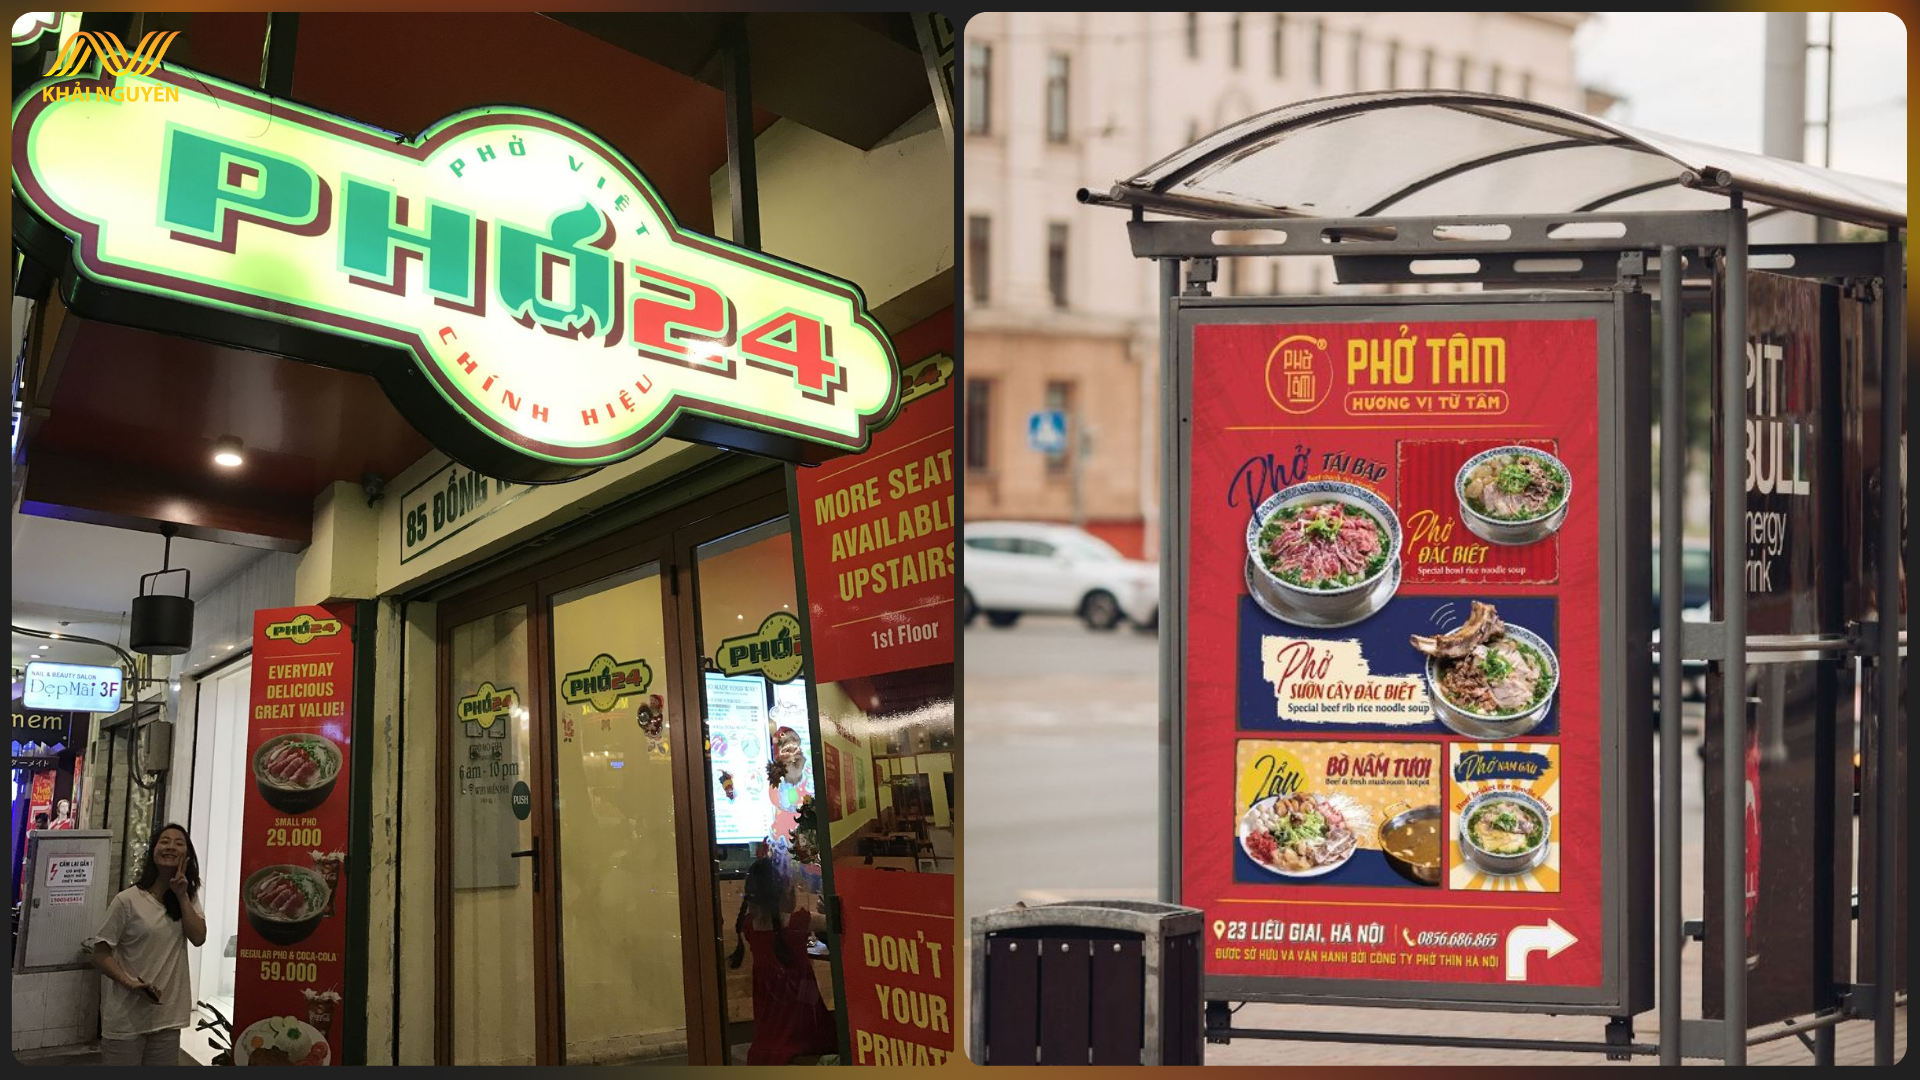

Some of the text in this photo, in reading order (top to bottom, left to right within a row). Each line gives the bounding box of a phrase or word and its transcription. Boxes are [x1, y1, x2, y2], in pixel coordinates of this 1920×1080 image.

[449, 134, 650, 236] PHỞ VIỆT
[1348, 324, 1506, 385] PHỞ TÂM
[438, 325, 653, 426] CHÍNH HIỆU
[1353, 393, 1501, 412] HƯƠNG VỊ TỪ TÂM
[1228, 444, 1311, 527] Phở
[1322, 450, 1352, 473] TÁI
[815, 477, 881, 526] MORE
[407, 502, 428, 547] 85
[1407, 509, 1455, 555] Phở
[1745, 510, 1787, 557] nergy
[1417, 566, 1444, 576] Special
[1466, 566, 1479, 575] rice
[1480, 566, 1506, 575] noodle
[1507, 567, 1526, 576] soup
[1745, 549, 1773, 593] rink
[871, 621, 940, 650] 1st Floor
[269, 662, 334, 680] EVERYDAY
[1277, 642, 1334, 694] Phở
[100, 681, 119, 697] 3F
[267, 682, 334, 700] DELICIOUS
[1326, 680, 1354, 700] CÂY
[255, 701, 345, 720] GREAT VALUE!
[1288, 703, 1430, 714] Special beef rib rice noodle soup
[459, 765, 465, 779] 6
[466, 766, 481, 779] am
[490, 761, 500, 777] 10
[502, 762, 519, 780] pm
[1326, 752, 1432, 778] BÒ NẤM TƯƠI
[1457, 754, 1498, 789] Phở
[1368, 778, 1405, 786] mushroom
[1406, 779, 1430, 787] hotpot
[513, 795, 529, 805] PUSH
[275, 817, 317, 827] SMALL PHO
[266, 828, 322, 847] 29.000
[1227, 921, 1247, 941] 23
[1357, 921, 1385, 949] NỘI
[1417, 931, 1498, 948] 0856.686.865
[240, 949, 337, 962] REGULAR PHO & COCA-COLA
[863, 930, 942, 979] DON'T
[1399, 952, 1413, 965] TY
[260, 961, 317, 983] 59.000
[875, 983, 949, 1034] YOUR
[856, 1029, 953, 1067] PRIVAT
